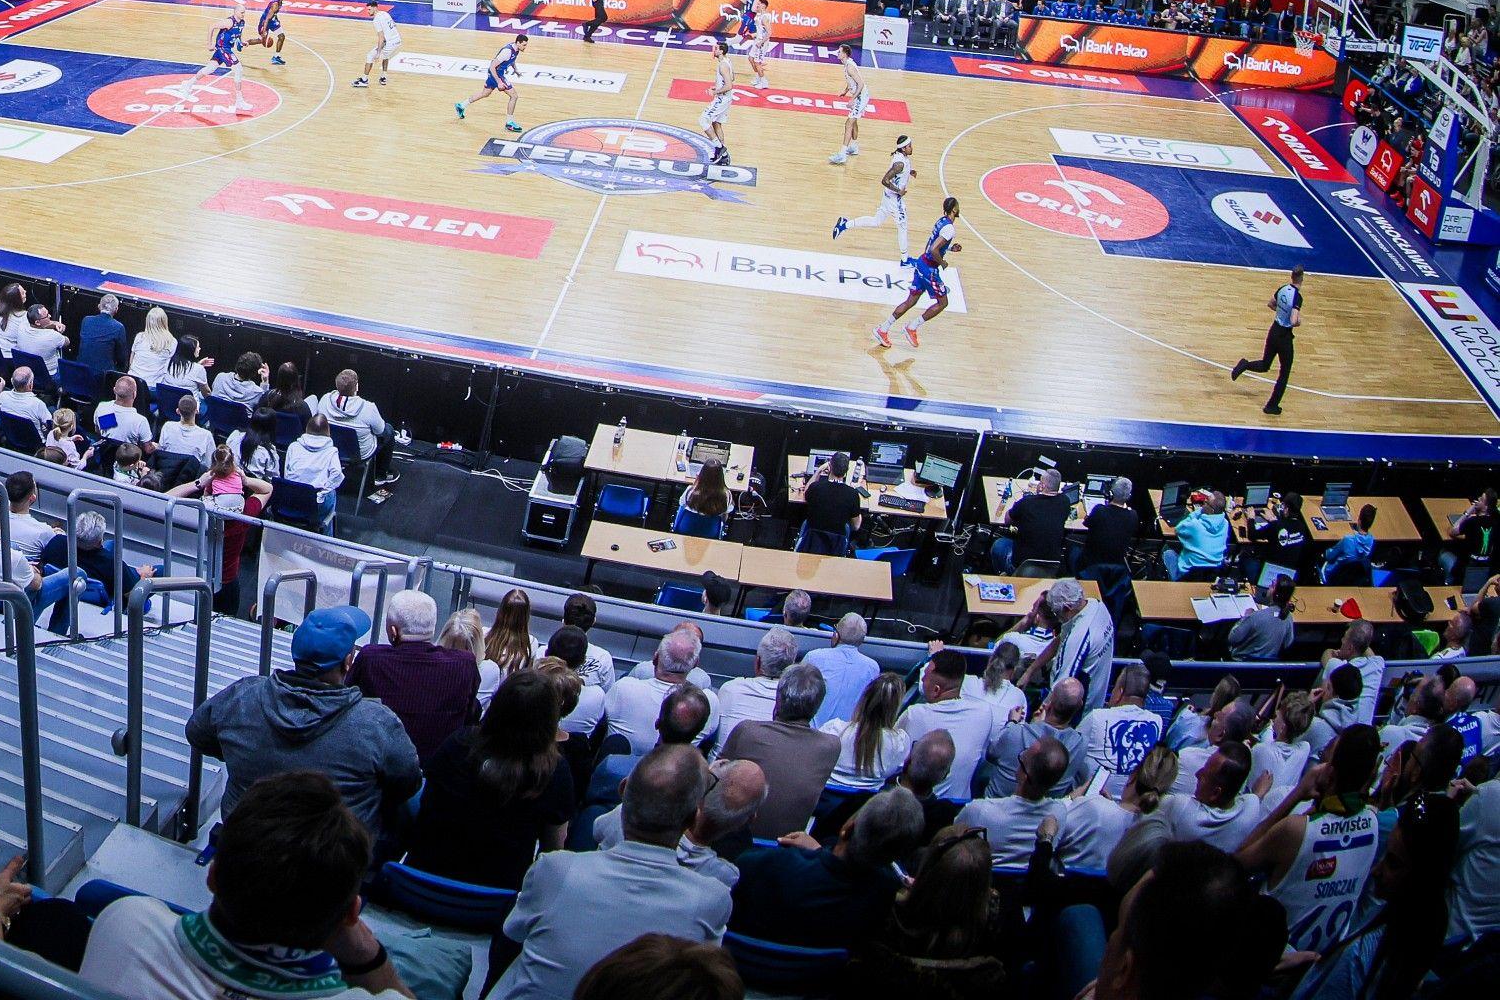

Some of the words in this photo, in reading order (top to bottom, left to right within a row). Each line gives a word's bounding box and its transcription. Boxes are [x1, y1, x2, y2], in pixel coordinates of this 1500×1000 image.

[8, 0, 70, 21] ORLEN
[781, 10, 819, 28] Pekao
[876, 38, 894, 46] ORLEN
[1085, 40, 1113, 55] Bank
[1115, 43, 1148, 59] Pekao
[1246, 57, 1271, 72] Bank
[1272, 60, 1301, 75] Pekao
[1, 69, 51, 92] SUZUKI
[534, 70, 615, 87] Pekao
[1029, 68, 1121, 85] ORLEN
[125, 103, 238, 114] ORLEN
[595, 129, 667, 154] TB
[1092, 133, 1162, 148] pre
[493, 139, 756, 183] TERBUD
[1100, 147, 1199, 164] zero
[1277, 133, 1329, 171] ORLEN
[1420, 163, 1441, 188] TERBUD
[1014, 191, 1123, 230] ORLEN
[1224, 198, 1260, 234] SUZUKI
[1444, 214, 1459, 223] pre
[344, 206, 501, 240] ORLEN
[1442, 223, 1463, 234] zero
[1371, 216, 1440, 278] WŁOCŁAWEK
[730, 256, 826, 282] Bank
[1320, 816, 1373, 836] anvistar
[1314, 878, 1359, 899] SOBCZAK
